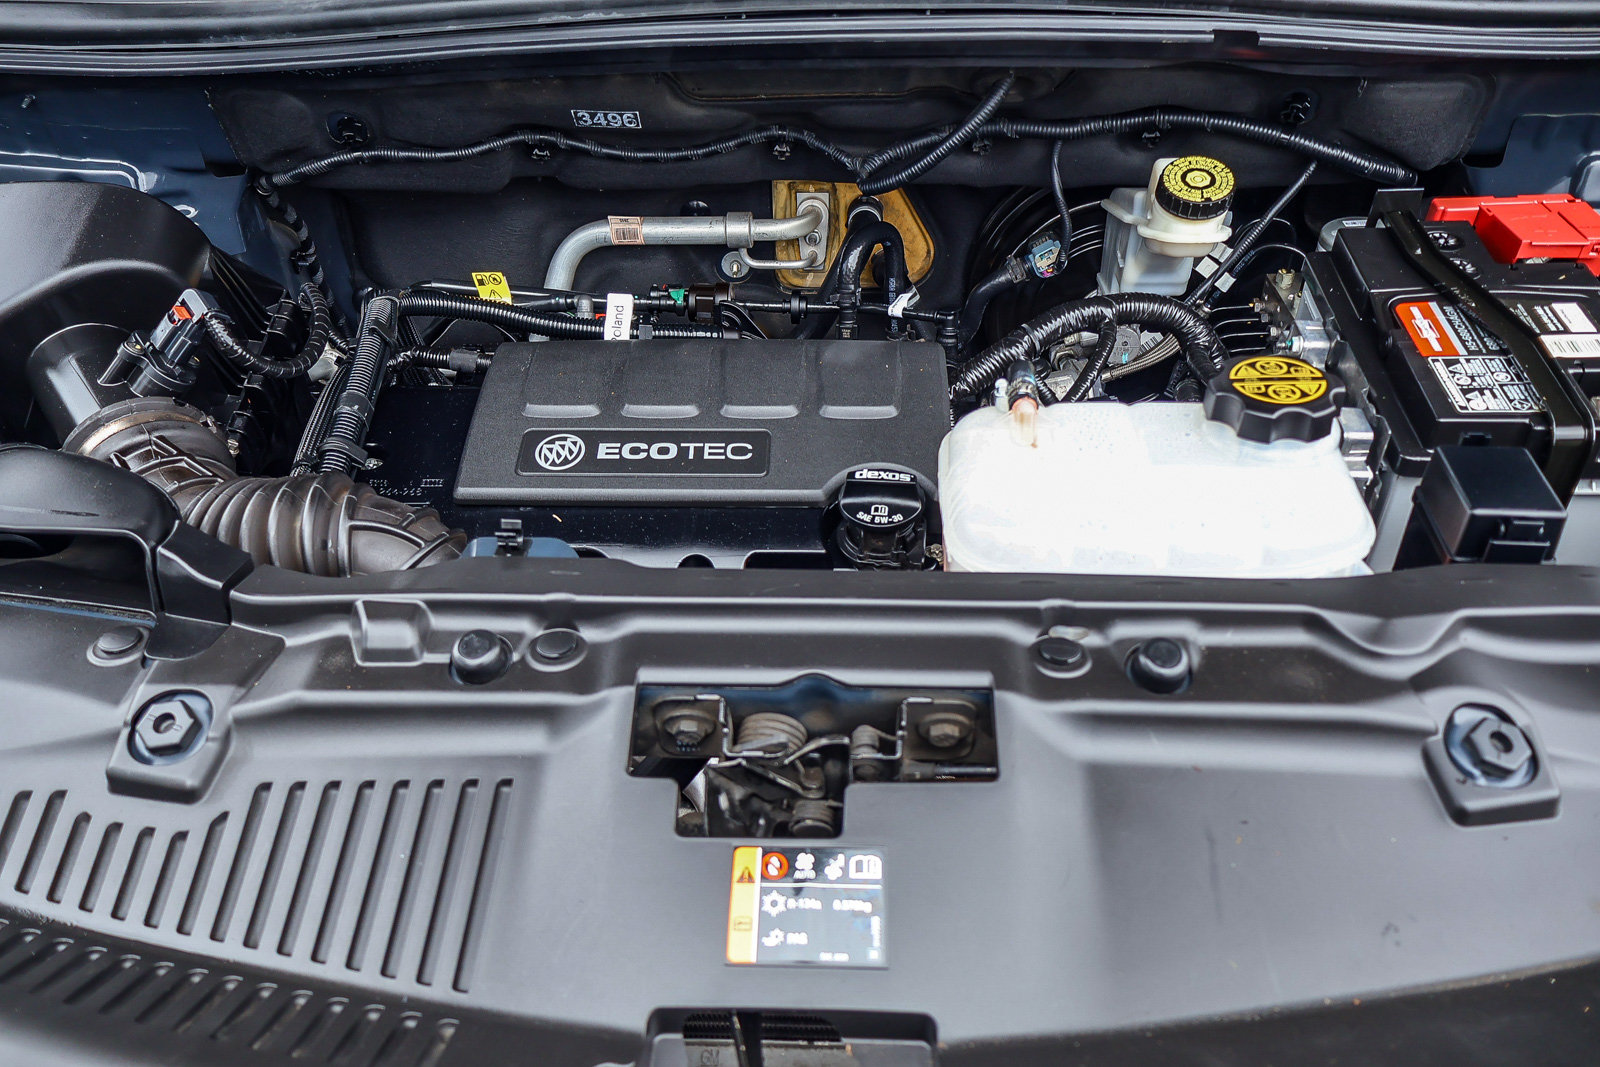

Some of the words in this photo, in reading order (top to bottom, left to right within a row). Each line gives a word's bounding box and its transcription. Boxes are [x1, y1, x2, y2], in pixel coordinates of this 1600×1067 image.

[577, 111, 637, 127] 3496
[597, 442, 753, 460] ECOTEC
[855, 468, 911, 482] dexos
[856, 511, 872, 522] SAE
[874, 513, 904, 524] 5W-30
